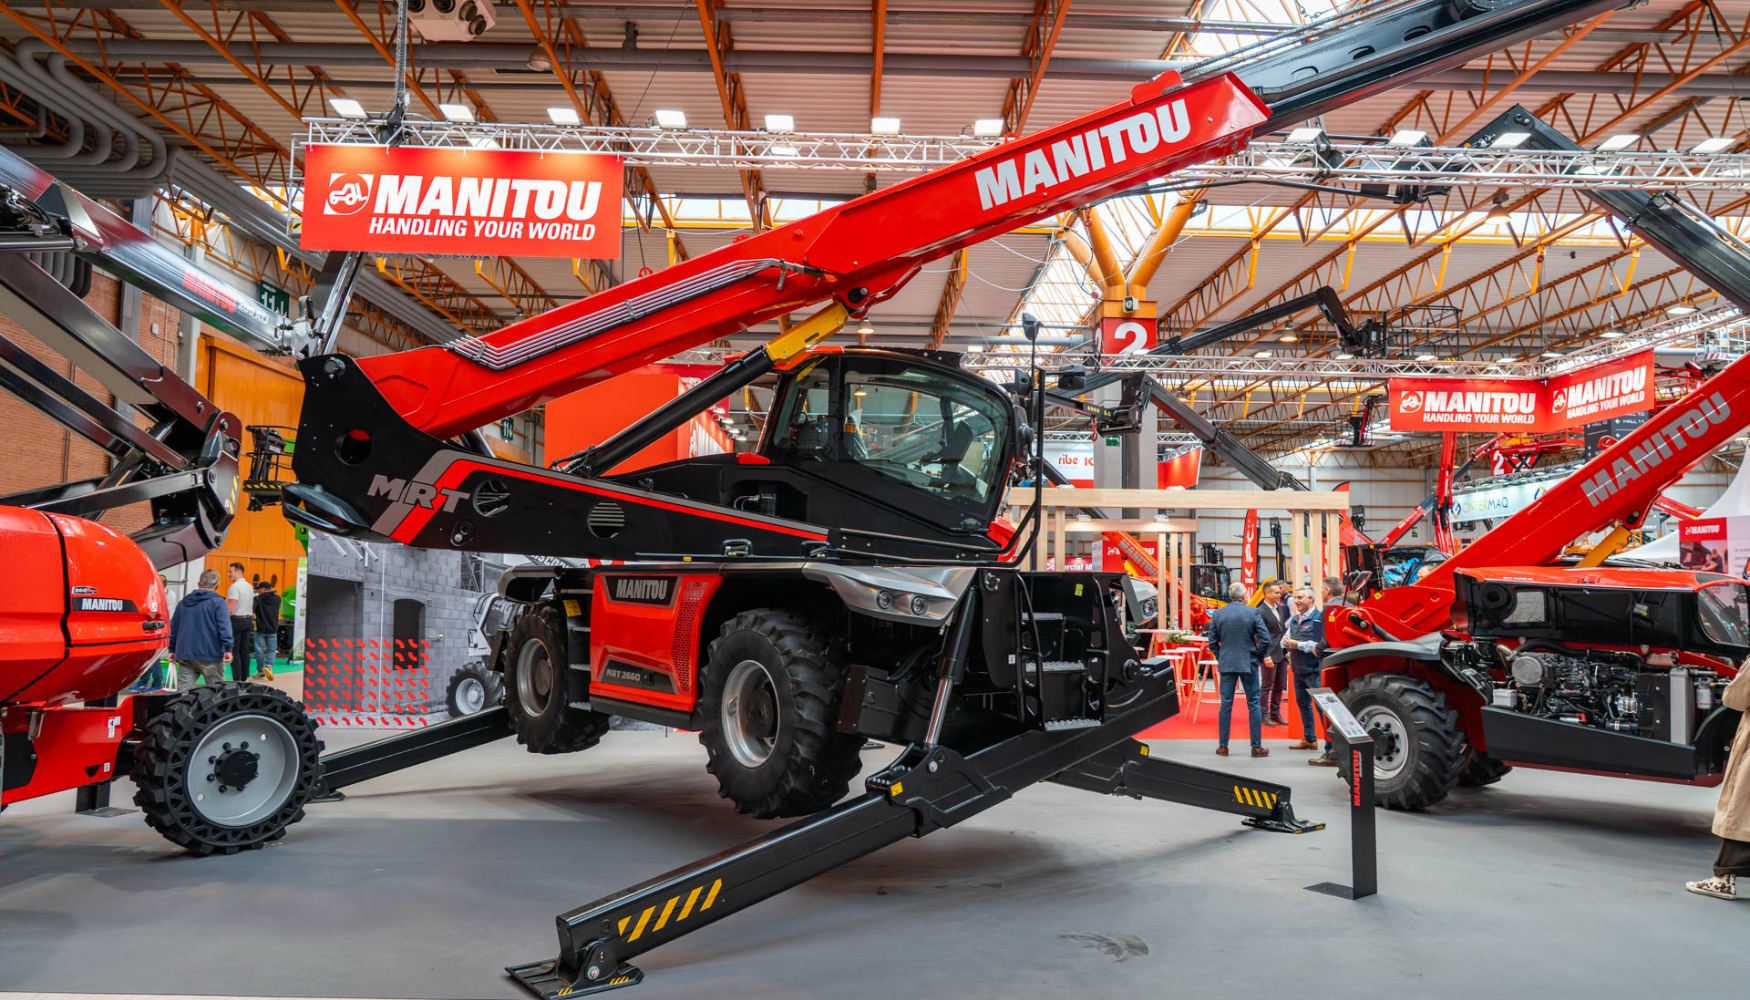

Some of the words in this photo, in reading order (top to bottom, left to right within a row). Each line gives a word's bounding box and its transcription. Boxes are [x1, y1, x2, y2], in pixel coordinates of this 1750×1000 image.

[974, 99, 1191, 211] MANITOU
[373, 174, 602, 221] MANITOU
[369, 217, 467, 237] HANDLING
[473, 220, 523, 239] YOUR
[528, 223, 596, 241] WORLD
[1114, 322, 1148, 366] 2
[1567, 365, 1647, 408] MANITOU
[1424, 391, 1536, 414] MANITOU
[1566, 401, 1600, 419] HANDLING
[1600, 397, 1619, 412] YOUR
[1619, 390, 1645, 407] WORLD
[1423, 412, 1472, 423] HANDLING
[1474, 413, 1499, 424] YOUR
[1501, 414, 1535, 424] WORLD
[1580, 391, 1731, 508] MANITOU
[366, 473, 471, 513] MRT
[1690, 525, 1720, 534] MANITOU
[616, 579, 668, 600] MANITOU
[81, 598, 123, 612] MANITOU
[606, 668, 621, 679] MRT
[622, 671, 641, 682] 2660
[1352, 750, 1361, 807] MANITOU
